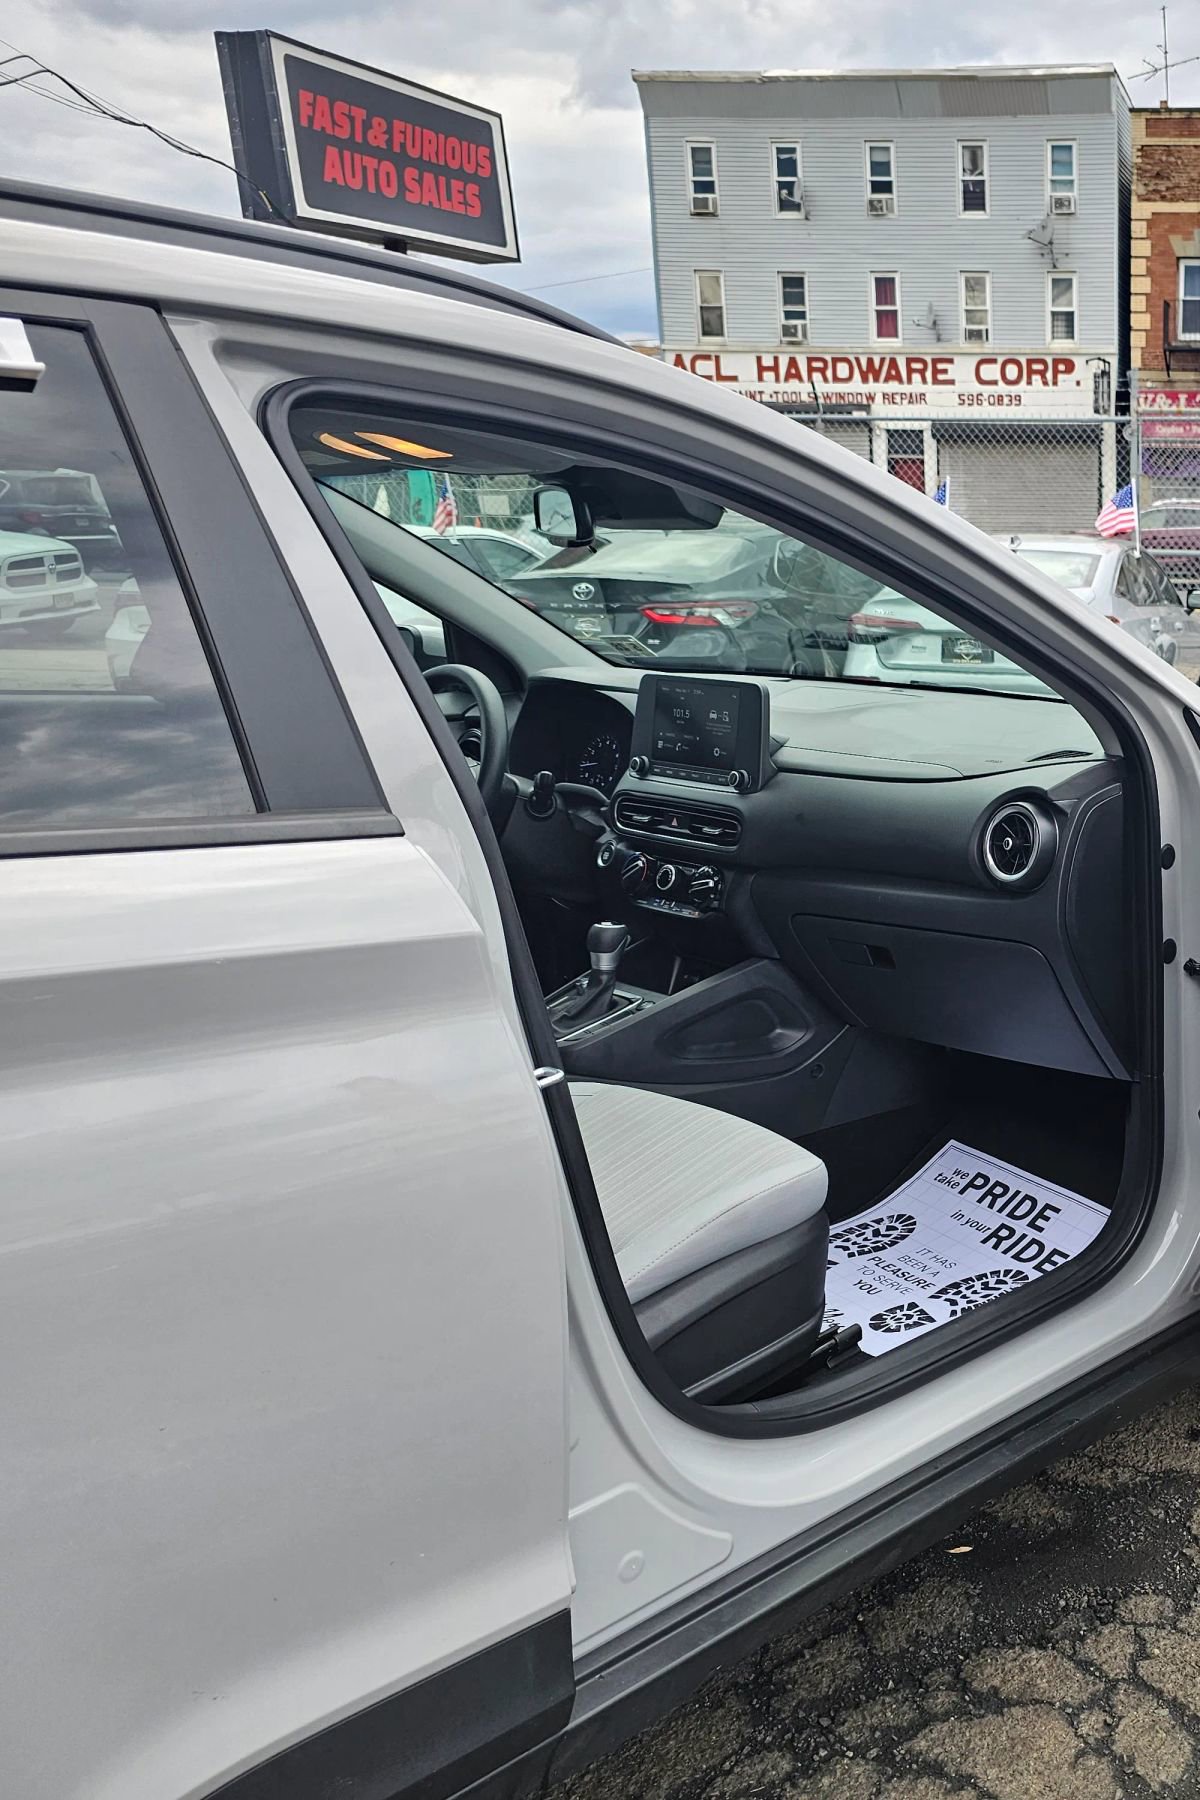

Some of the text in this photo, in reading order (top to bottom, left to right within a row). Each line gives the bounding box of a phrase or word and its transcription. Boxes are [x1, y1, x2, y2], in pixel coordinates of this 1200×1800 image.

[298, 89, 492, 178] FAST & FURIOUS
[323, 145, 481, 217] AUTO SALES
[674, 354, 1081, 386] ACL HARDWARE CORP.
[882, 392, 927, 405] REPAIR
[673, 708, 690, 719] 101.5
[952, 1167, 970, 1180] we
[934, 1171, 1063, 1233] take PRIDE
[951, 1209, 1070, 1275] in your RIDE
[898, 1254, 940, 1278] BEEN A
[918, 1247, 956, 1268] IT HAS
[854, 1279, 881, 1296] YOU
[856, 1265, 914, 1295] TO SERVE
[867, 1256, 937, 1291] PLEASURE
